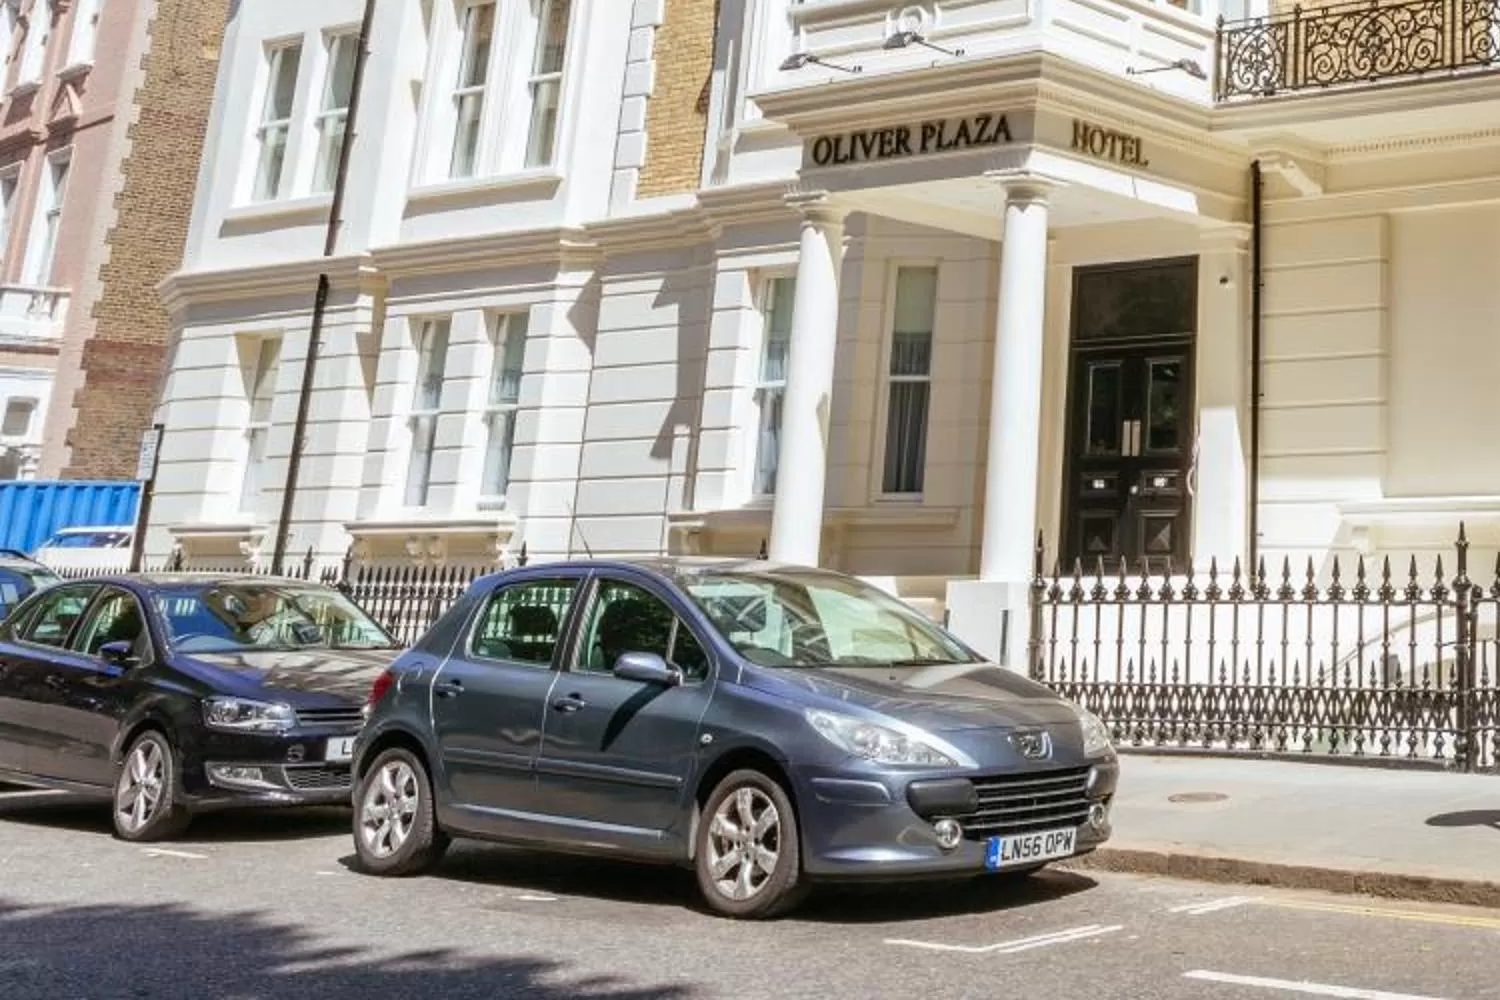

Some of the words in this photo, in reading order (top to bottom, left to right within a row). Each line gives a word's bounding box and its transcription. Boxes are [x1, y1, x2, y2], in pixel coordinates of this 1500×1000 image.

[812, 125, 912, 165] OLIVER
[919, 113, 1013, 154] PLAZA
[1071, 118, 1149, 168] HOTEL
[1001, 835, 1042, 861] LN56
